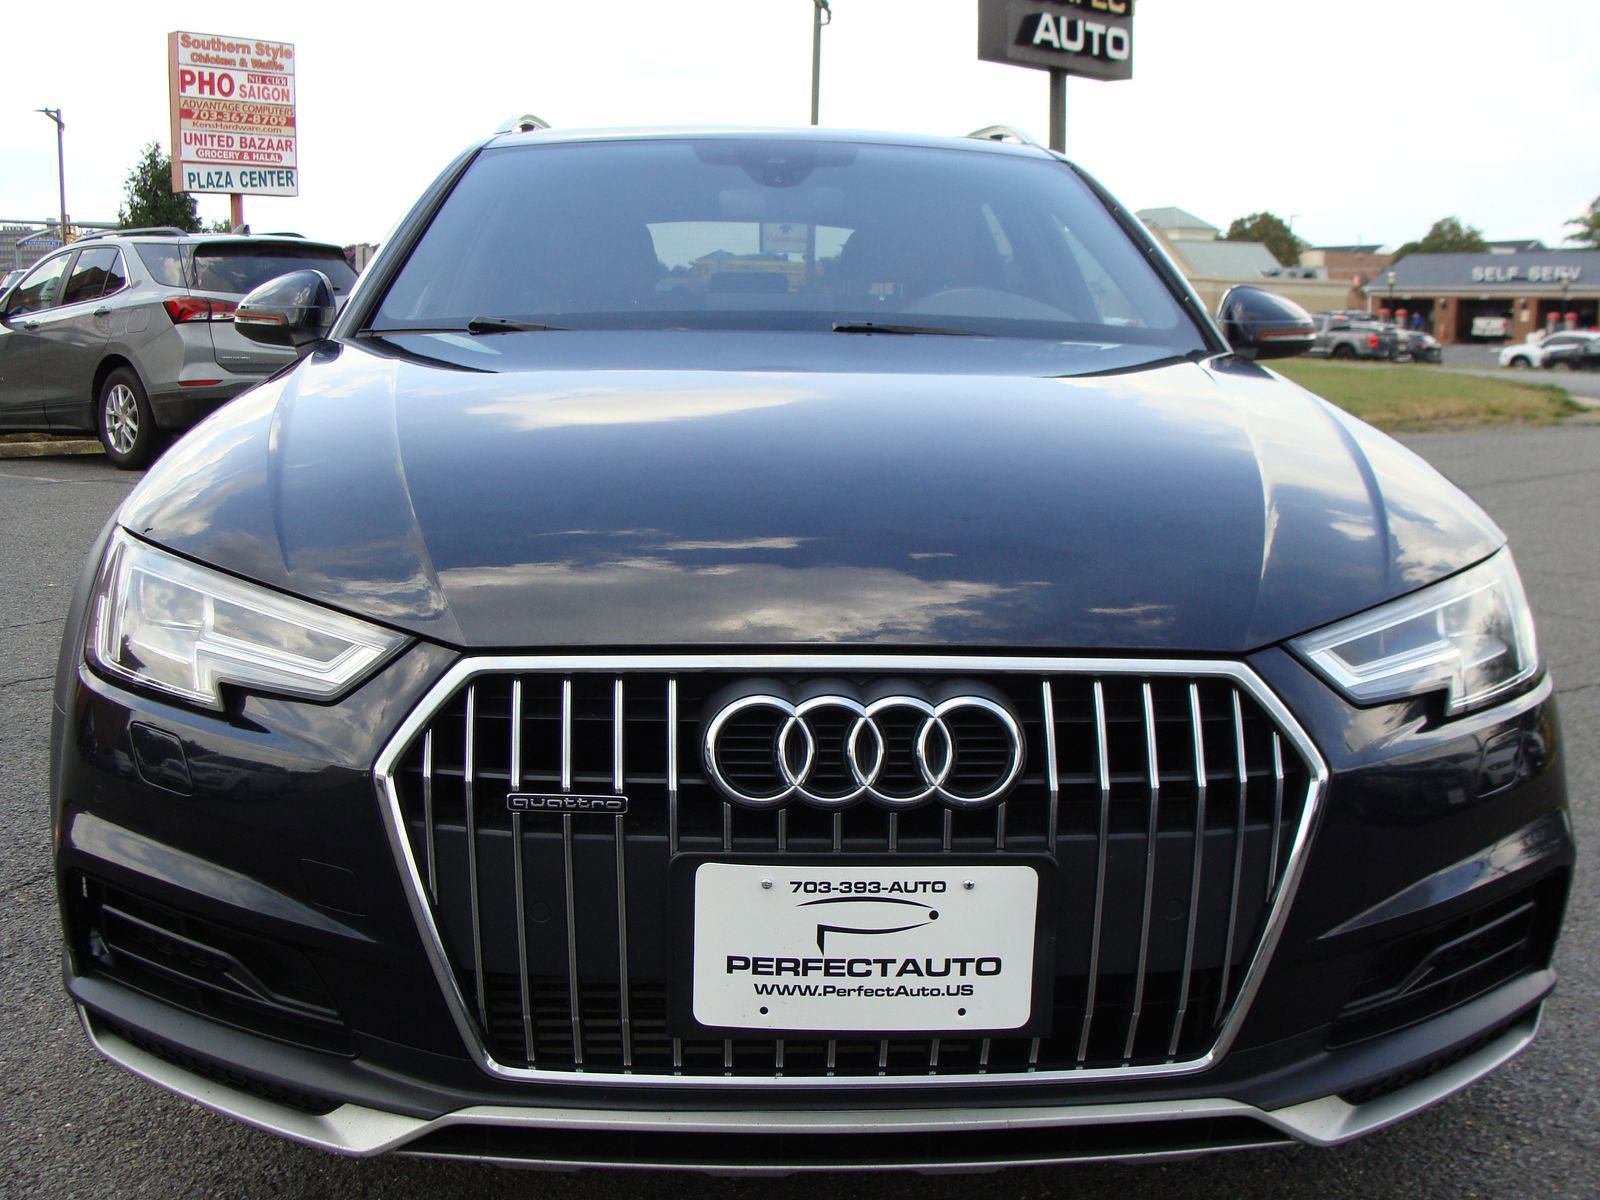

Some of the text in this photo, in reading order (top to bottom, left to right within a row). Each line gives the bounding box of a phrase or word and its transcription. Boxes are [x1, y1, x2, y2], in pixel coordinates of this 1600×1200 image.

[1032, 12, 1130, 61] AUTO
[181, 34, 293, 60] Southern Style
[190, 52, 237, 66] Chicken
[239, 58, 248, 68] &
[180, 69, 235, 97] PHO
[239, 84, 290, 102] SAIGON
[182, 99, 294, 117] ADVANTAGE COMPUTERS
[191, 110, 287, 126] 703-367-8709
[193, 121, 282, 134] KensHardware.com
[183, 133, 293, 152] UNITED BAZAAR
[198, 149, 281, 162] GROCERY & HALAL
[188, 170, 295, 189] PLAZA CENTER
[1472, 265, 1519, 282] SELF
[512, 797, 622, 809] quattro
[789, 880, 947, 894] 703-393-AUTO
[726, 955, 1002, 978] PERFECTAUTO
[754, 983, 974, 998] WWW.PerfectAuto.US
